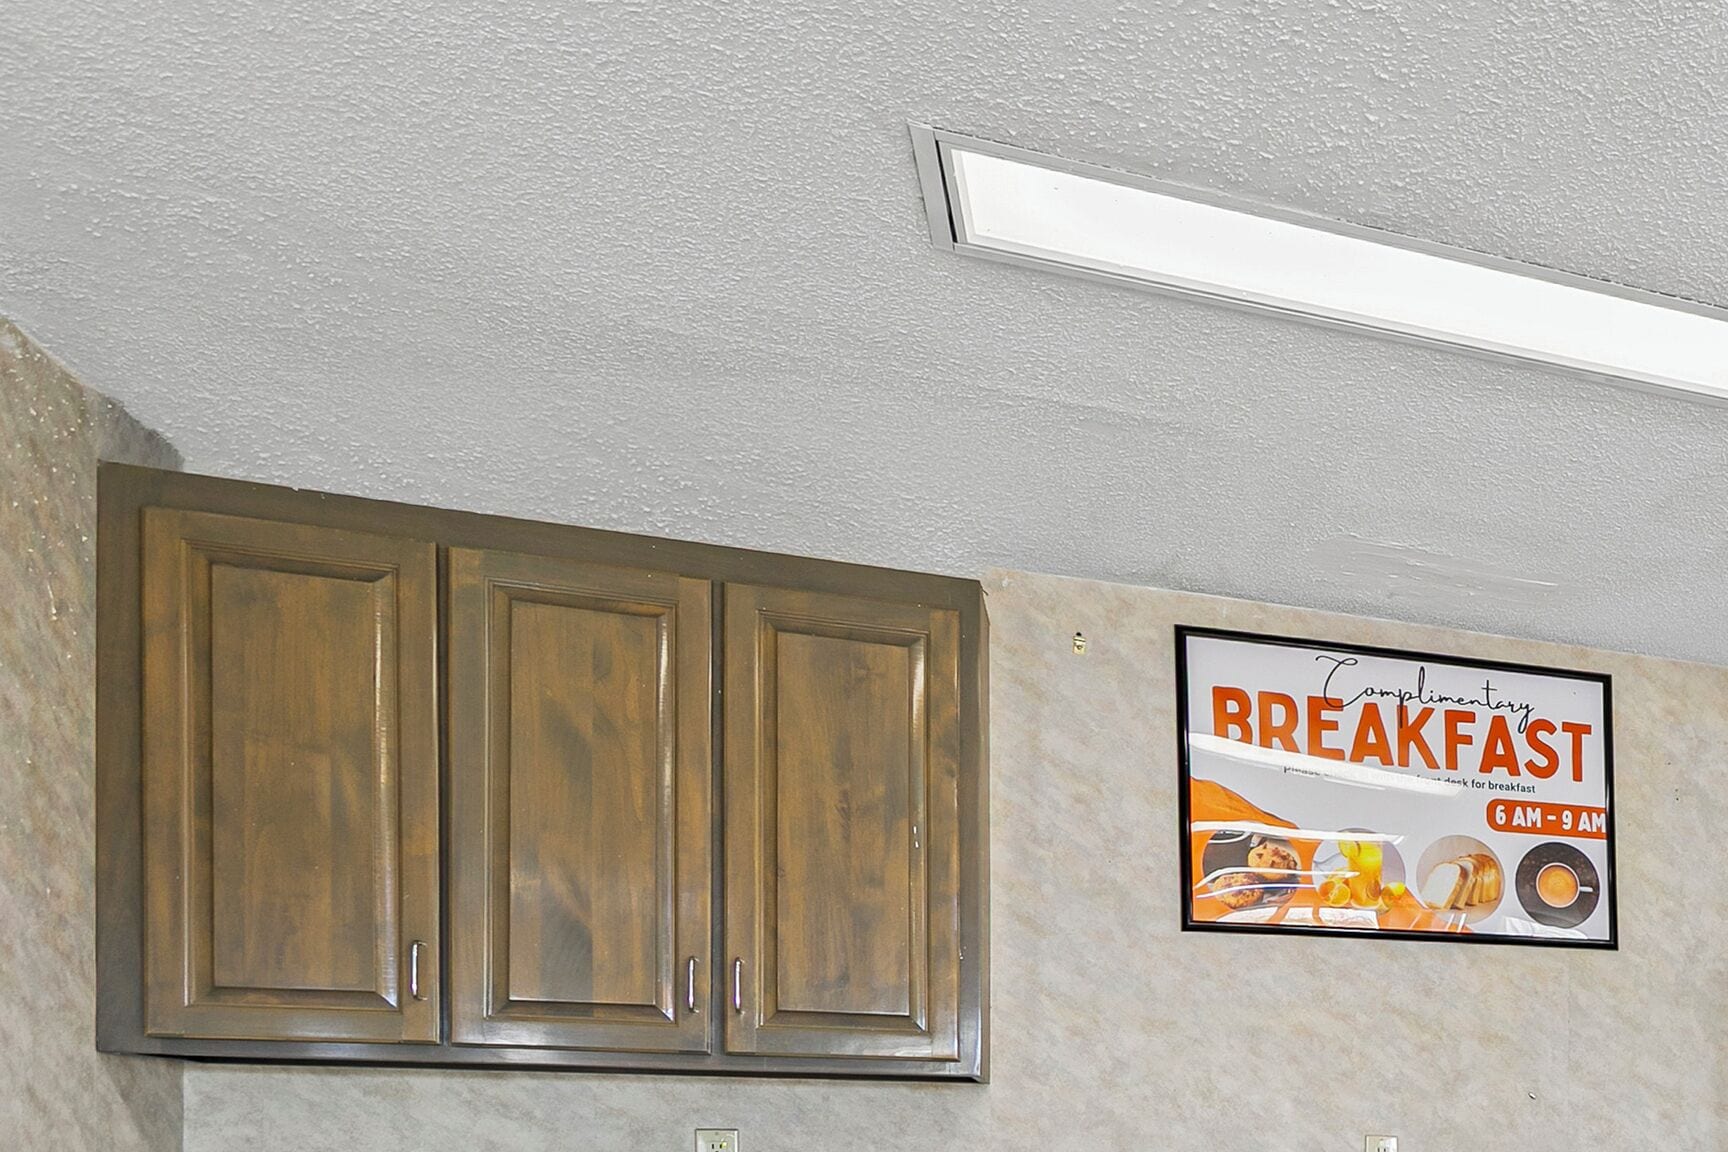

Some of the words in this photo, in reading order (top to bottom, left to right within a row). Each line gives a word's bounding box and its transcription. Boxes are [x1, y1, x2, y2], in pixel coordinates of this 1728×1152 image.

[1315, 655, 1535, 734] Complimentary
[1212, 686, 1592, 783] BREAKFAST
[1471, 778, 1486, 789] for
[1488, 780, 1536, 794] breakfast
[1495, 804, 1507, 825] 6
[1512, 806, 1542, 828] AM
[1561, 810, 1573, 830] 9
[1577, 811, 1606, 833] AM
